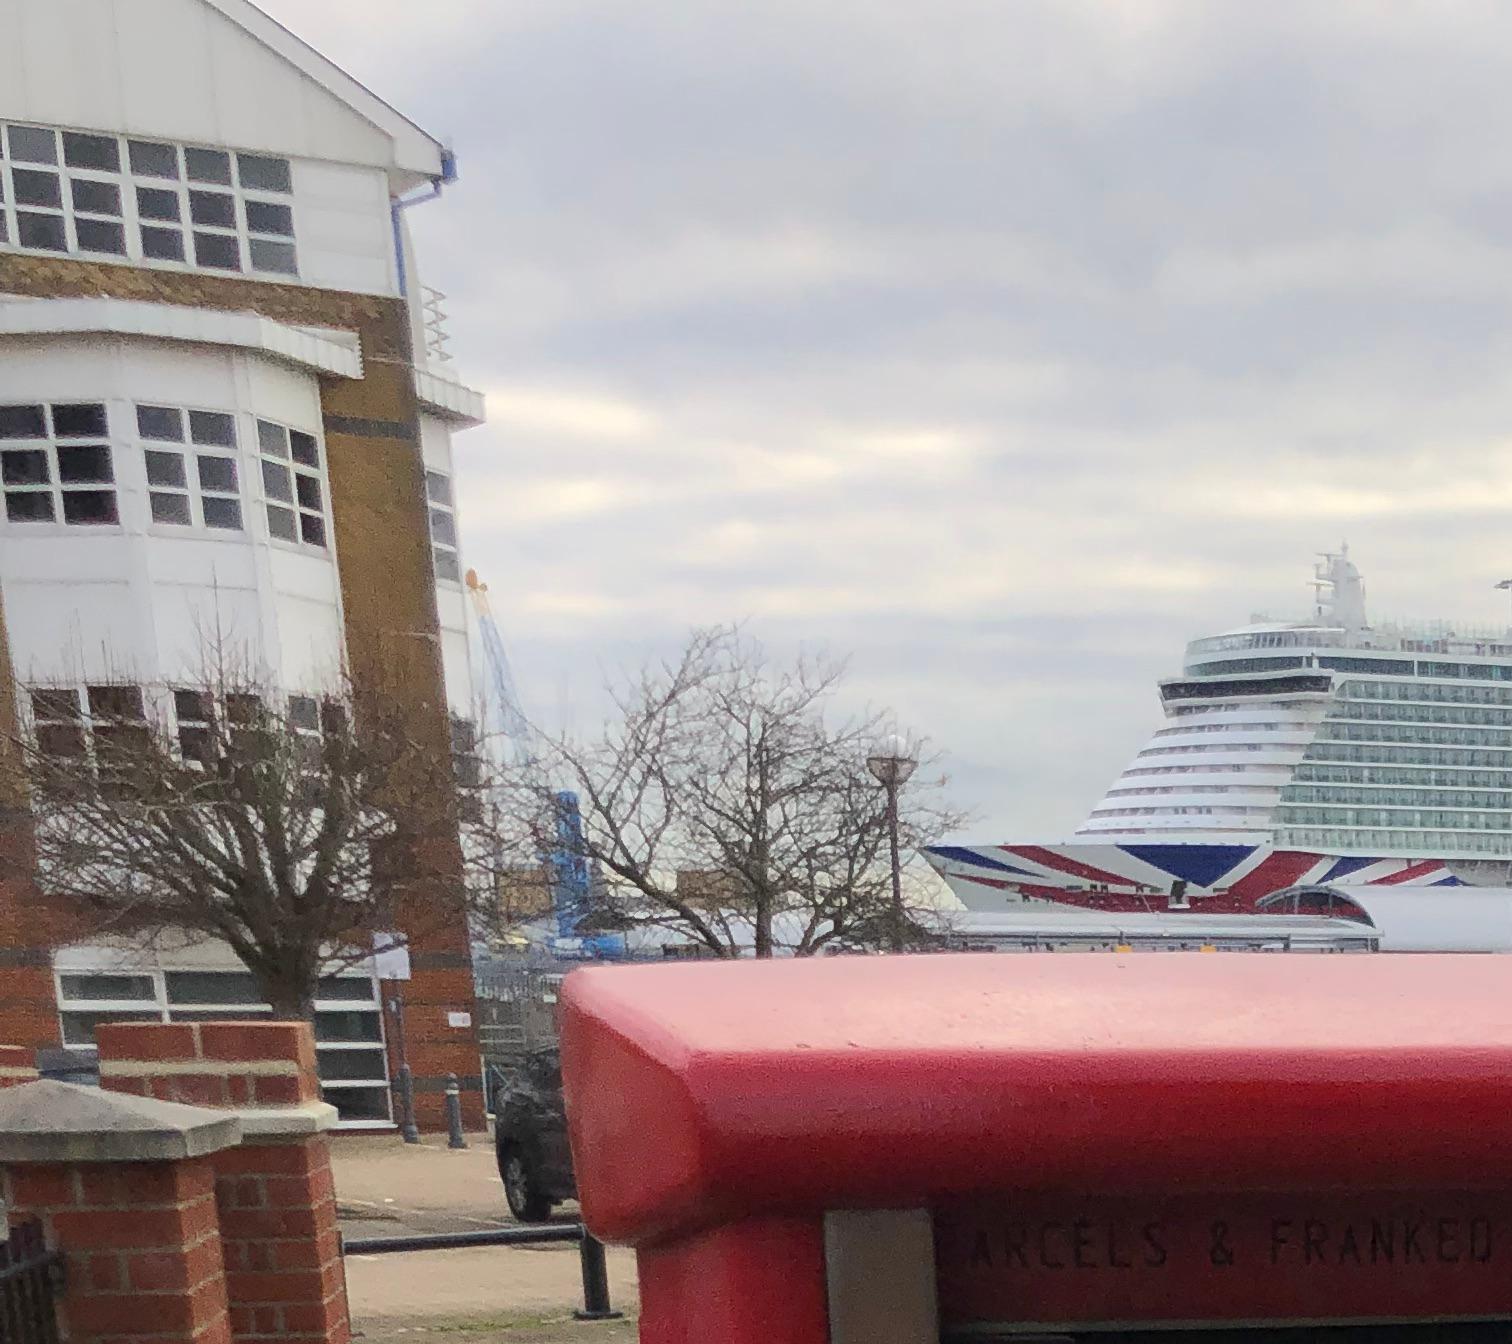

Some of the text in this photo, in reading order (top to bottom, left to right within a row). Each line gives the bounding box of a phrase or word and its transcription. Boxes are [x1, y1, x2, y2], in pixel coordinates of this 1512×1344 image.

[955, 1215, 1170, 1270] ARCELS
[1206, 1220, 1237, 1267] &
[1268, 1214, 1494, 1268] FRANKED
